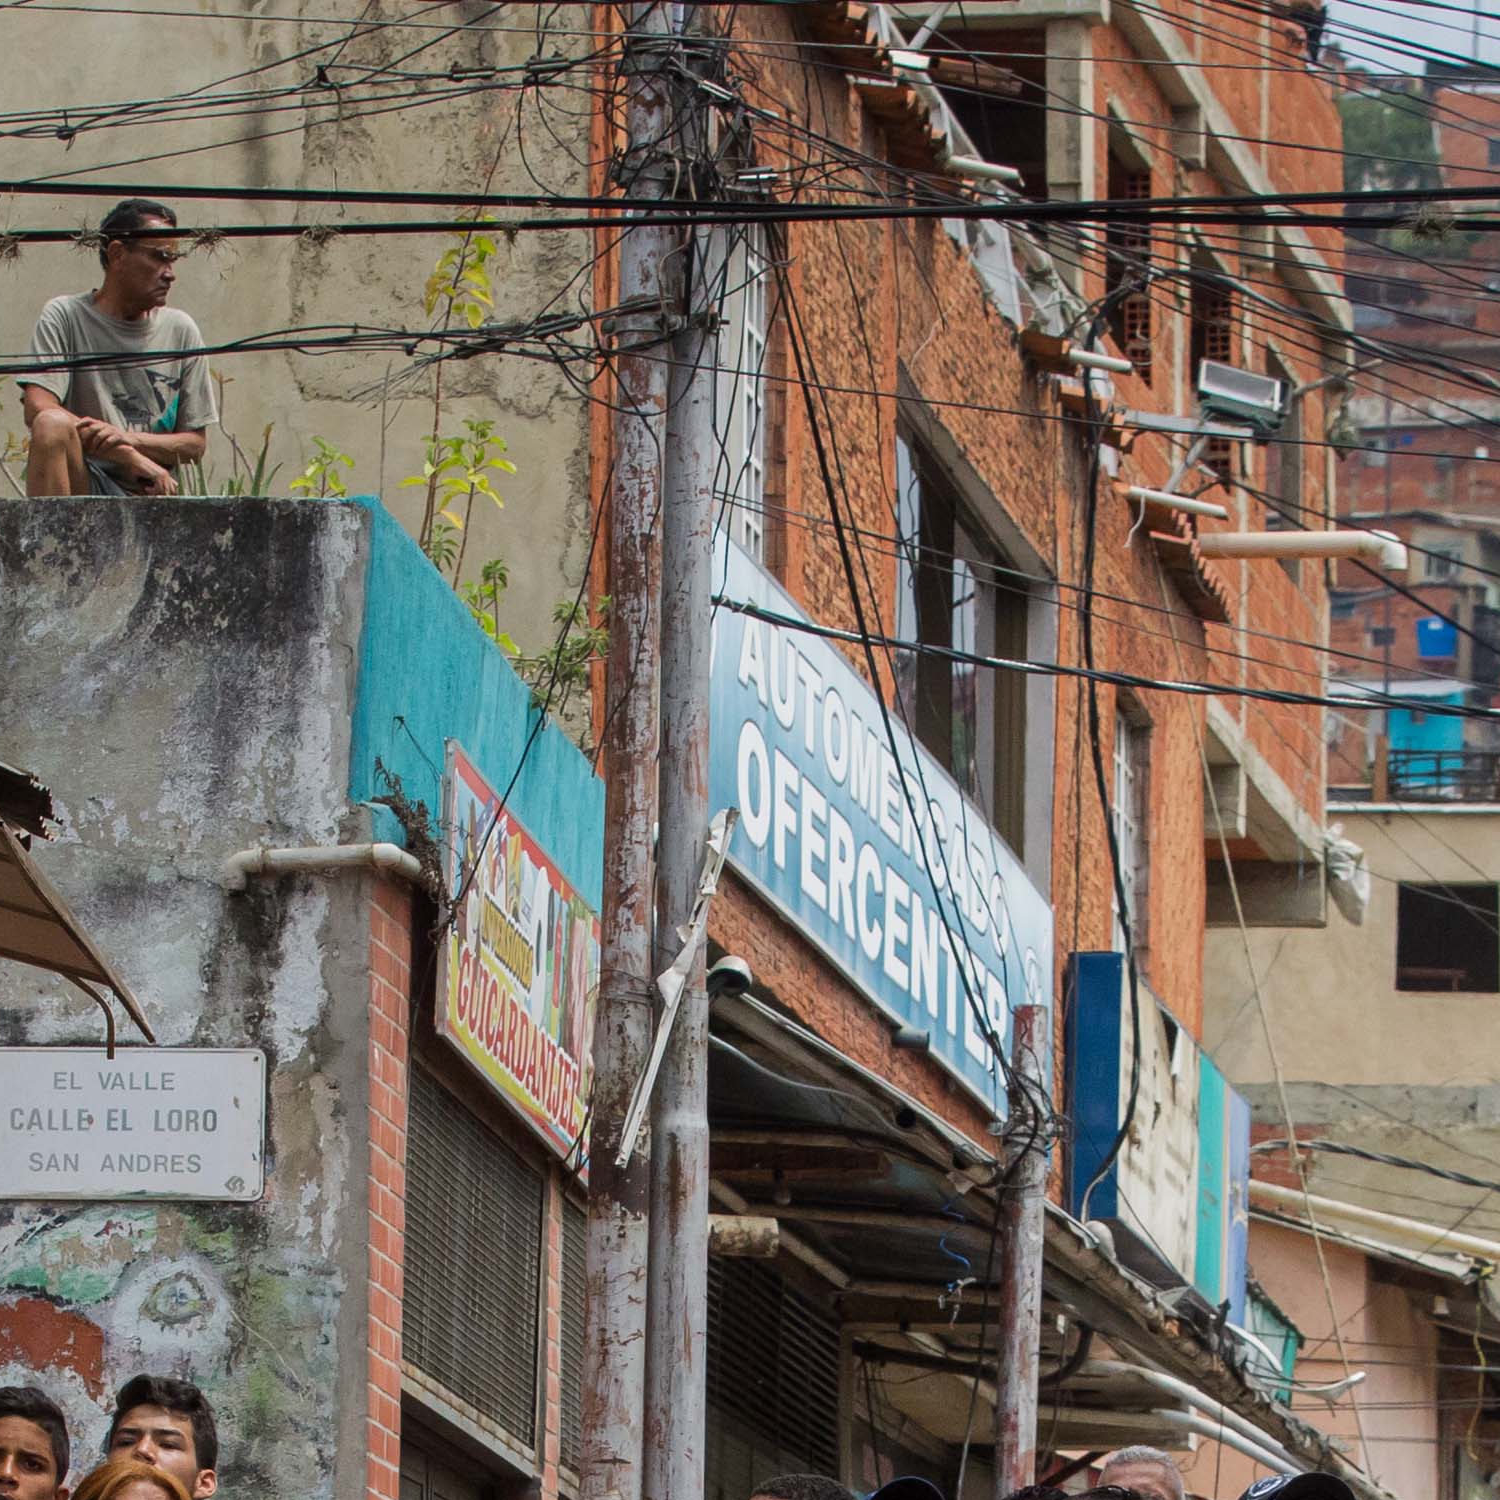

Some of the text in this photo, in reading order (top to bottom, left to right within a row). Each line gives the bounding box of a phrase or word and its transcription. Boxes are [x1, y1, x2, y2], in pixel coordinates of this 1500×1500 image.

[737, 617, 1009, 958] AUTOMERCADO
[737, 719, 1007, 1092] OFERCENTER
[53, 1071, 176, 1092] EL VALLE
[10, 1108, 218, 1133] CALLE EL LORO
[28, 1152, 202, 1175] SAN ANDRES
